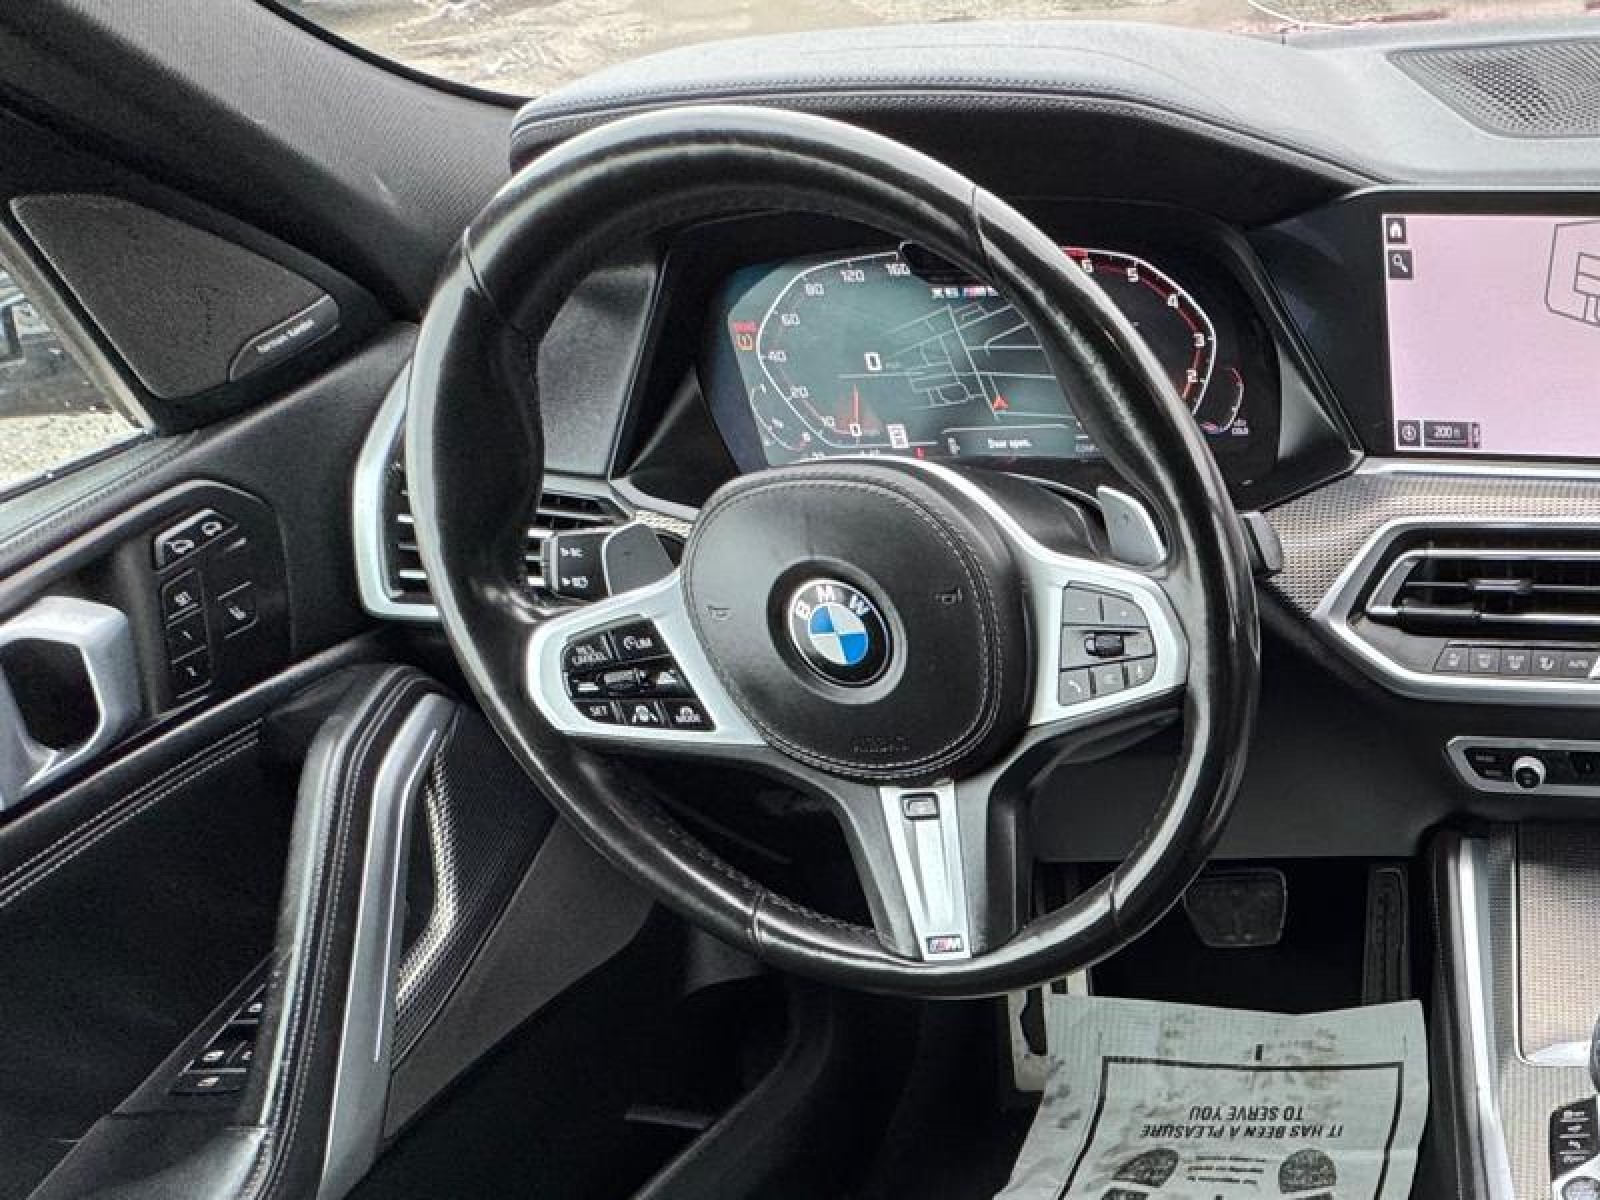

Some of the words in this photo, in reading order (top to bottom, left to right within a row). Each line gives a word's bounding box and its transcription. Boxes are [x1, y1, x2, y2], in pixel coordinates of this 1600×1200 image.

[841, 269, 865, 283] 120
[886, 263, 911, 276] 160
[1126, 267, 1140, 282] 5
[805, 283, 825, 296] 80
[1167, 293, 1179, 308] 4
[781, 313, 801, 326] 60
[1194, 333, 1206, 347] 3
[768, 350, 787, 363] 40
[863, 352, 882, 371] 0
[1186, 369, 1198, 383] 2
[790, 386, 808, 398] 20
[820, 416, 835, 427] 10
[849, 424, 862, 436] 0
[1433, 425, 1453, 439] 200
[795, 584, 871, 620] BMW
[1188, 1105, 1222, 1121] YOU
[1227, 1105, 1279, 1121] SERVE
[1283, 1105, 1304, 1121] TO
[1139, 1123, 1225, 1139] PLEASURE
[1229, 1124, 1241, 1140] A
[1243, 1124, 1287, 1139] BEEN
[1289, 1124, 1324, 1138] HAS
[1326, 1124, 1344, 1139] IT
